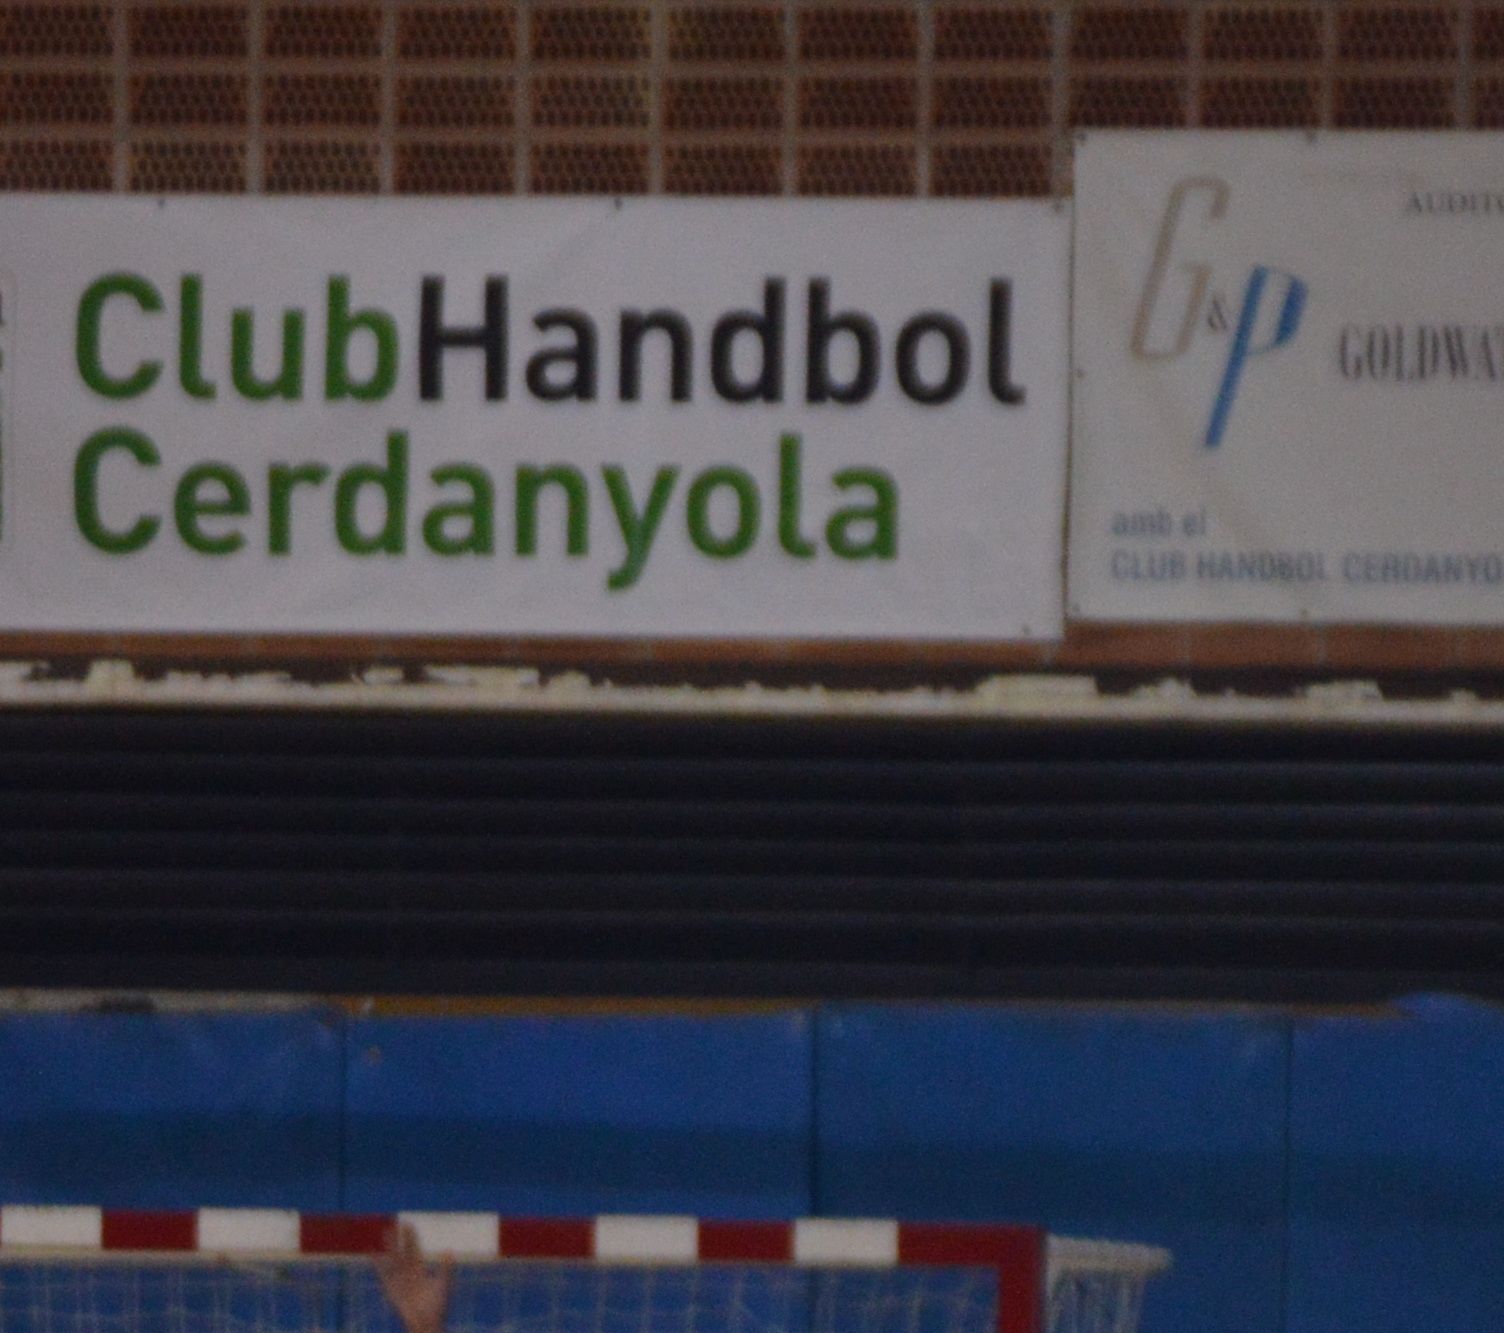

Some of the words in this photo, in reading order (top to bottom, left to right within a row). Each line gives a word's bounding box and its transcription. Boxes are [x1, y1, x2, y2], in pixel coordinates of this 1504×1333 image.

[76, 271, 1026, 403] ClubHandbol
[73, 425, 899, 592] Cerdanyola
[1109, 505, 1175, 537] amb
[1180, 505, 1208, 537] el
[1109, 548, 1187, 581] CLUB
[1197, 549, 1327, 582] HANDBOL
